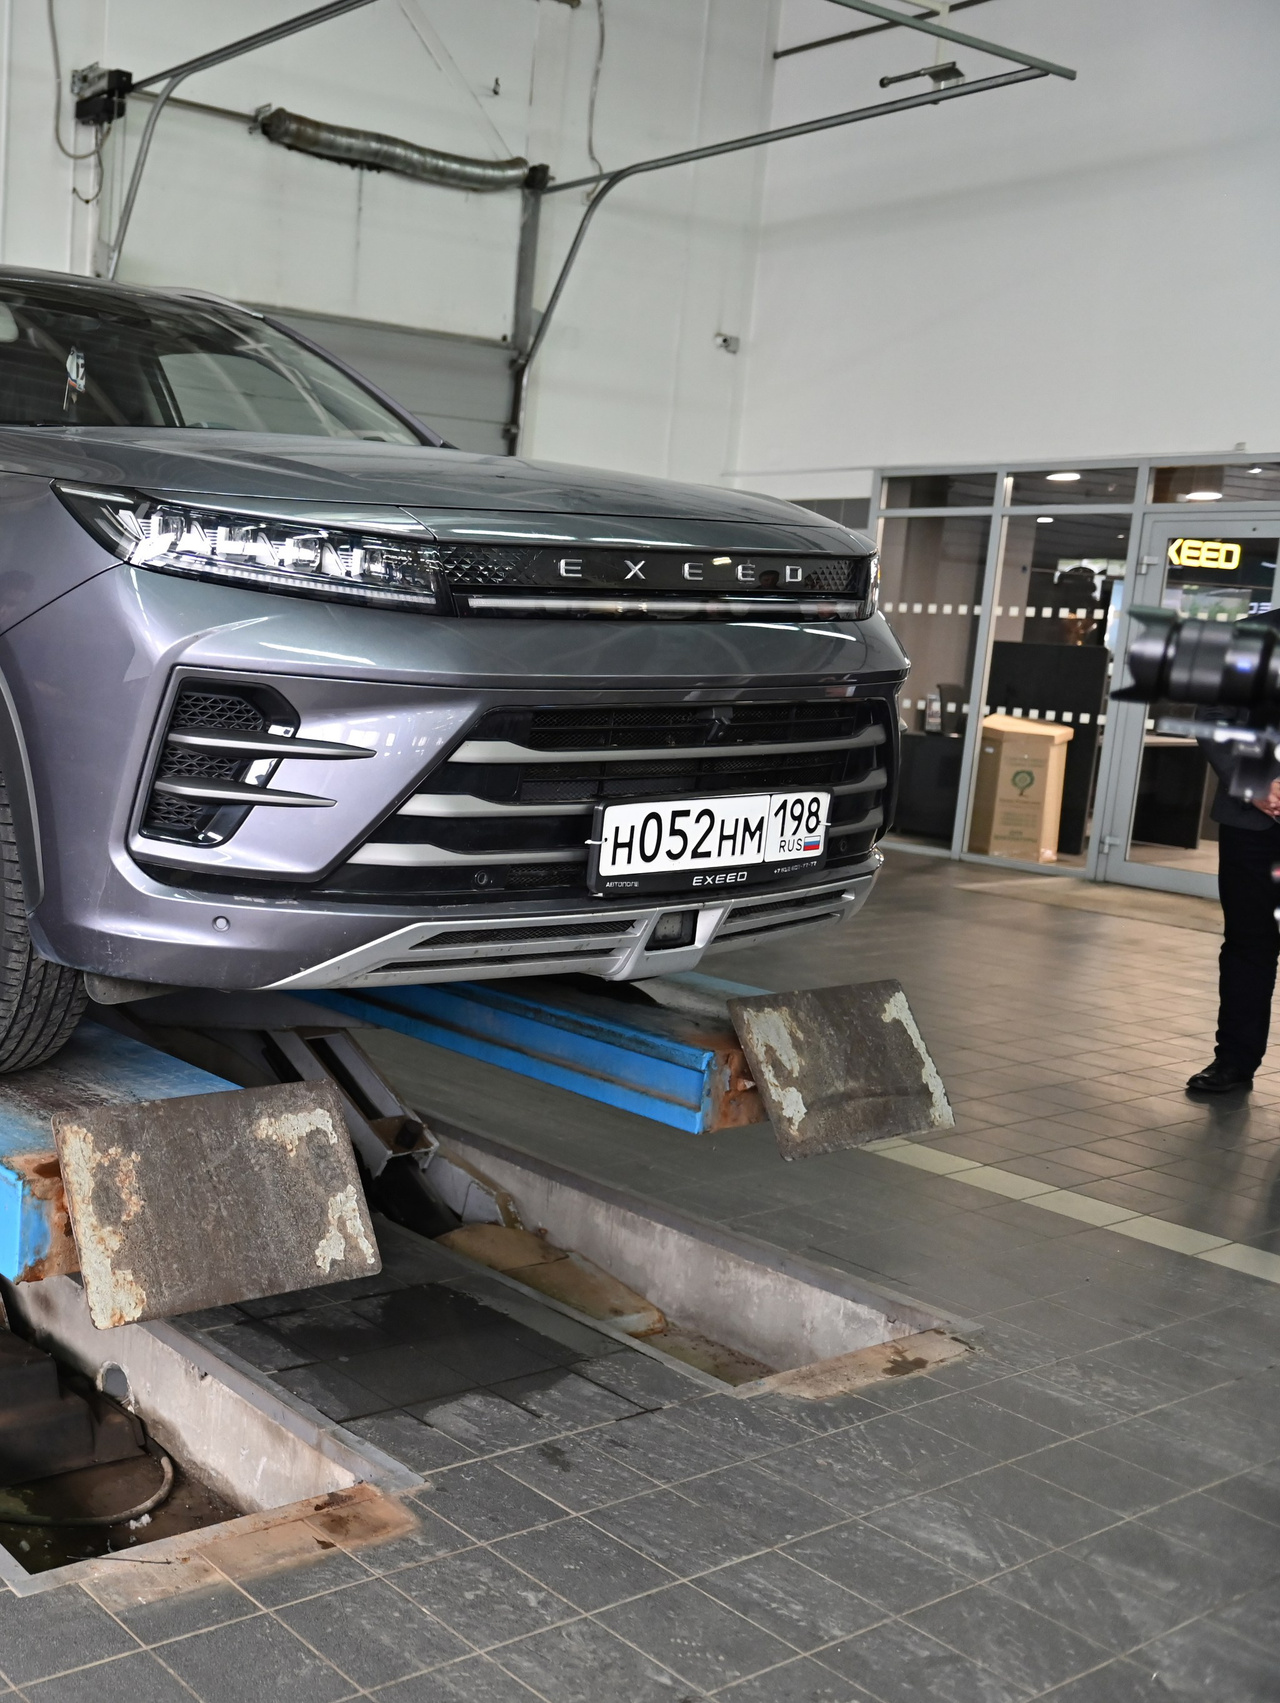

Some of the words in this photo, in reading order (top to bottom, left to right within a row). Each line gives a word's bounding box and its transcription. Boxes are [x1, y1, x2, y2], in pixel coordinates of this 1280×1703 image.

[558, 558, 802, 583] EXEED
[611, 808, 765, 866] Н052НМ
[774, 797, 821, 838] 198
[778, 838, 803, 853] RUS
[692, 871, 748, 886] EXEED
